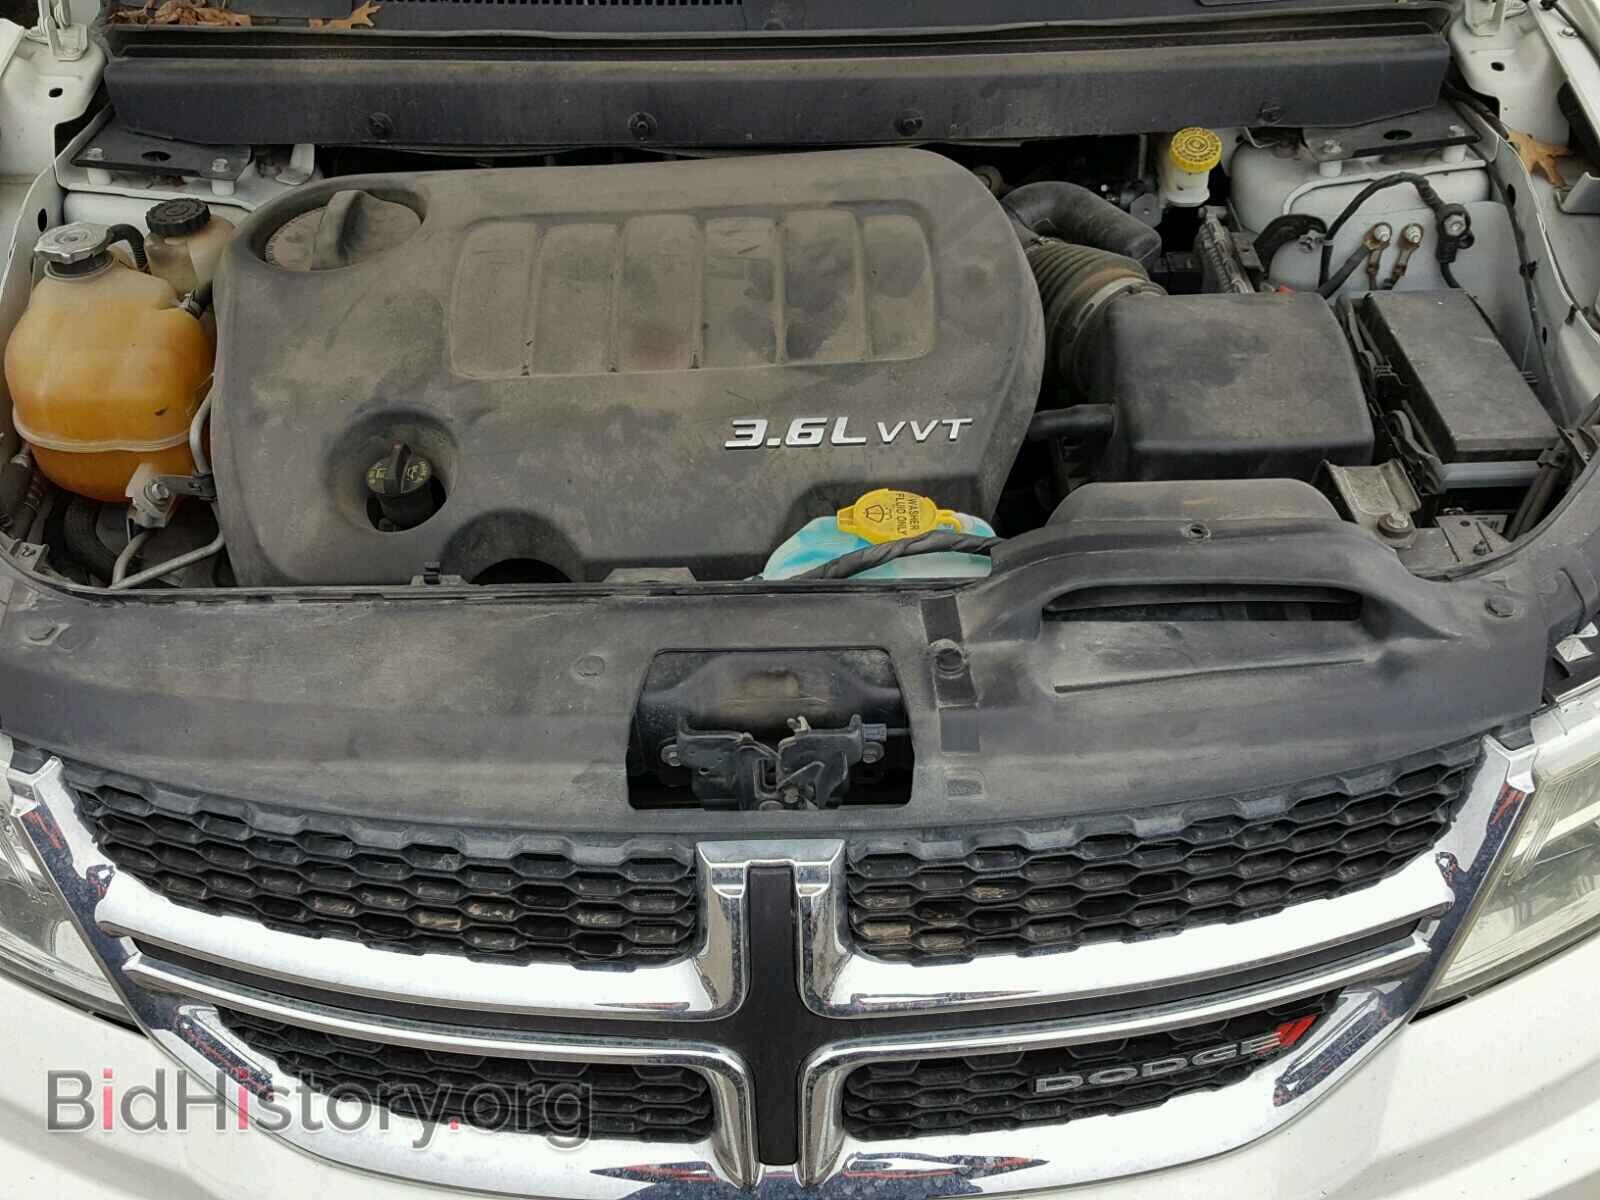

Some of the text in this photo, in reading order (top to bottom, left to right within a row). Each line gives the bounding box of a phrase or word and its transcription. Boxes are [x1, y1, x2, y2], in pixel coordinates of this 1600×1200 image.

[725, 417, 973, 448] 3.6L VVT
[896, 493, 908, 536] FLUID ONLY
[908, 497, 921, 530] WASHER
[1035, 1031, 1282, 1093] DODGE
